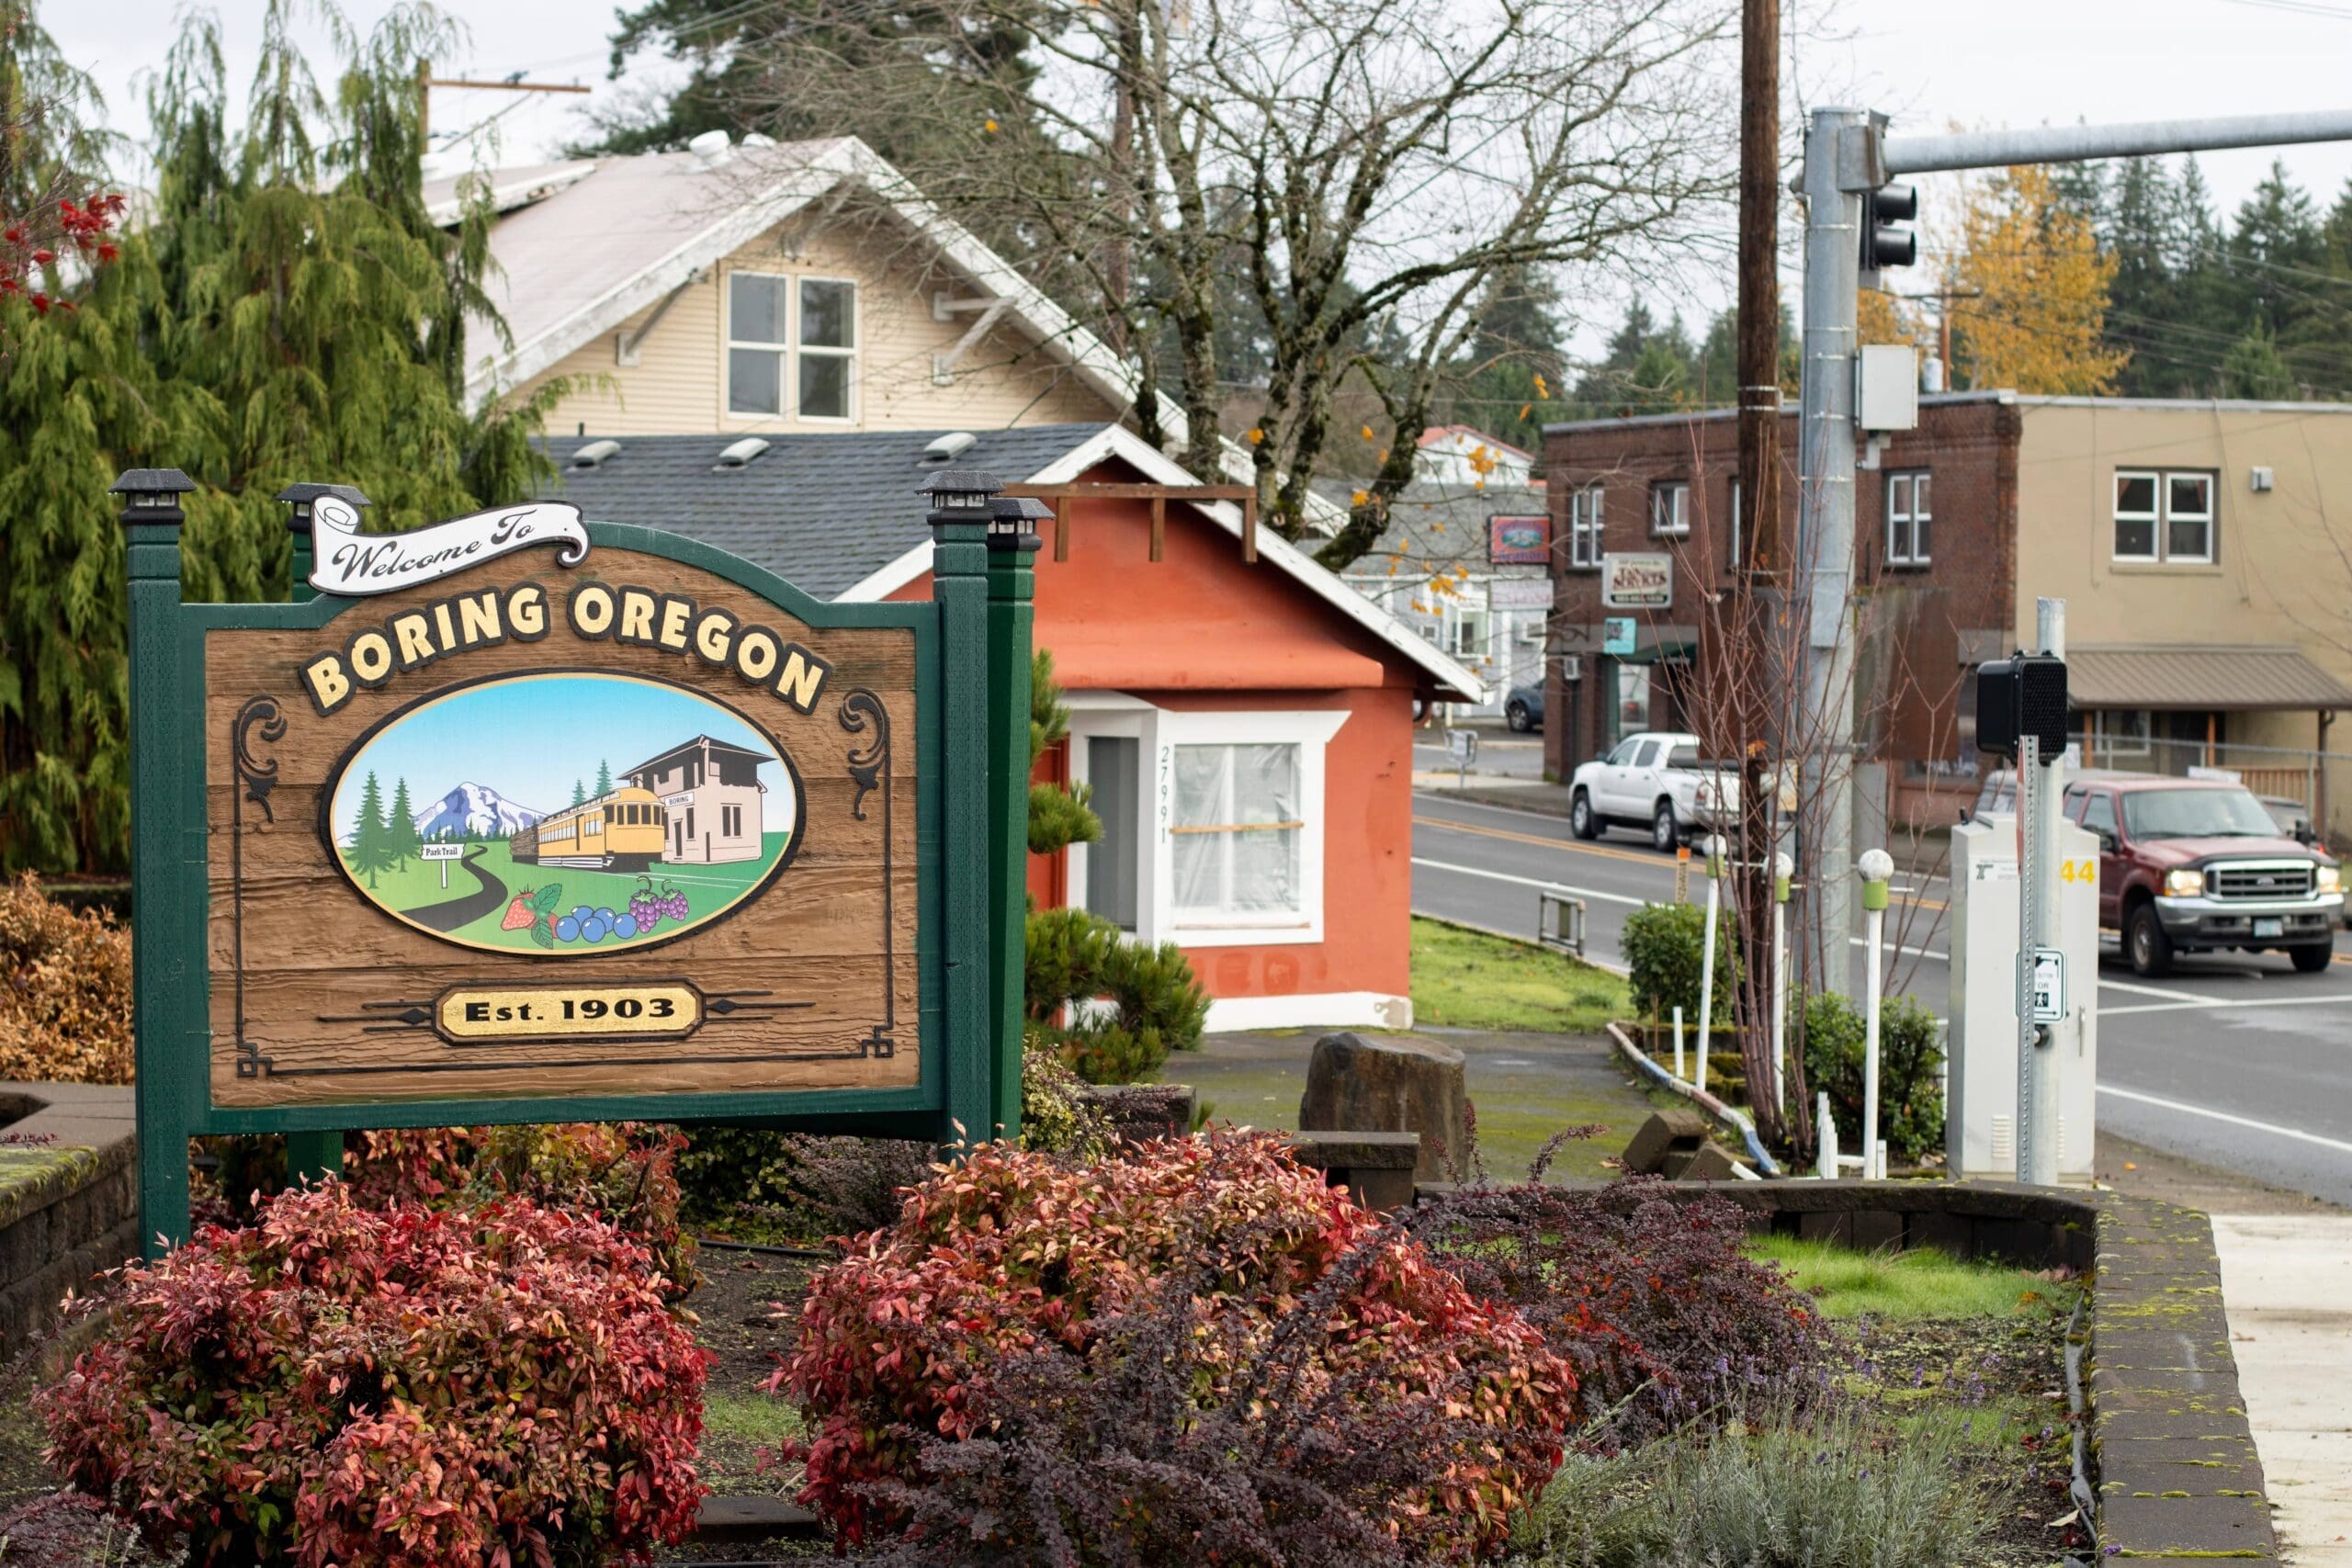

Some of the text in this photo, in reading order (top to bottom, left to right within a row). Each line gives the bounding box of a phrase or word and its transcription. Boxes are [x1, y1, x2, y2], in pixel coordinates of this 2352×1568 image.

[332, 509, 537, 582] Welcome To
[307, 587, 823, 708] BORING OREGON
[669, 795, 689, 805] BORING
[1161, 746, 1170, 843] 27991
[442, 847, 458, 855] Trail
[2061, 860, 2095, 884] 44
[465, 998, 675, 1022] Est. 1903
